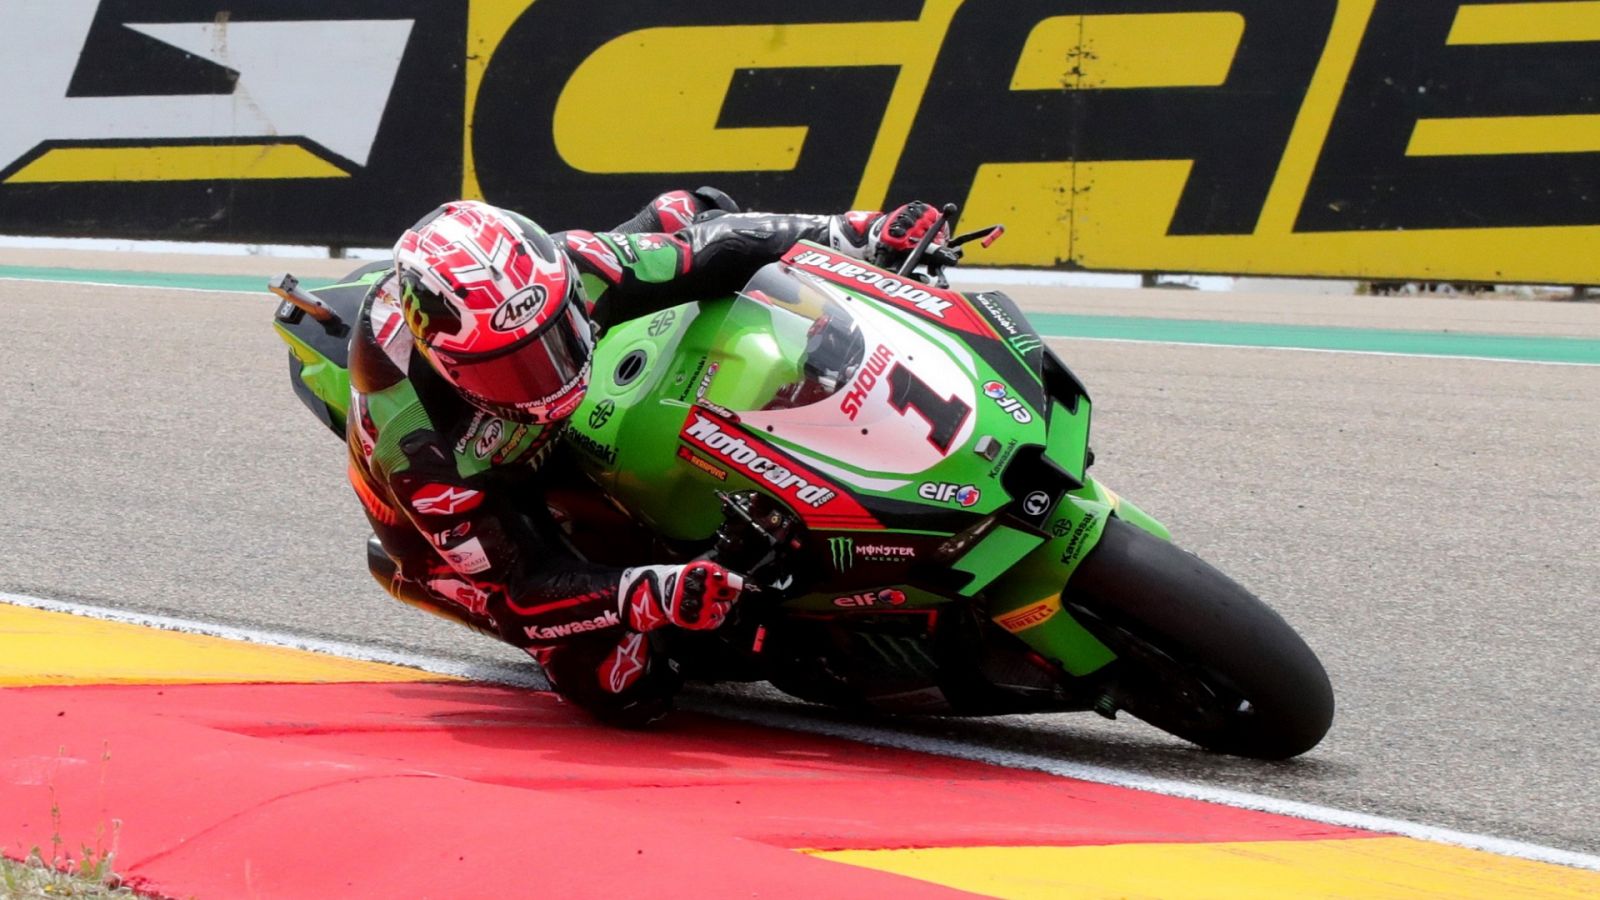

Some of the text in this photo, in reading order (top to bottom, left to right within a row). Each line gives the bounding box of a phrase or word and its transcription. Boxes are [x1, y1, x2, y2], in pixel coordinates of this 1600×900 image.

[499, 287, 541, 329] Arai
[840, 344, 894, 421] SHOWA
[887, 361, 972, 456] 1
[988, 439, 1018, 479] Kawasaki
[856, 544, 915, 557] MONSTER
[524, 610, 620, 641] Kawasak
[1000, 604, 1054, 630] PIRELLI
